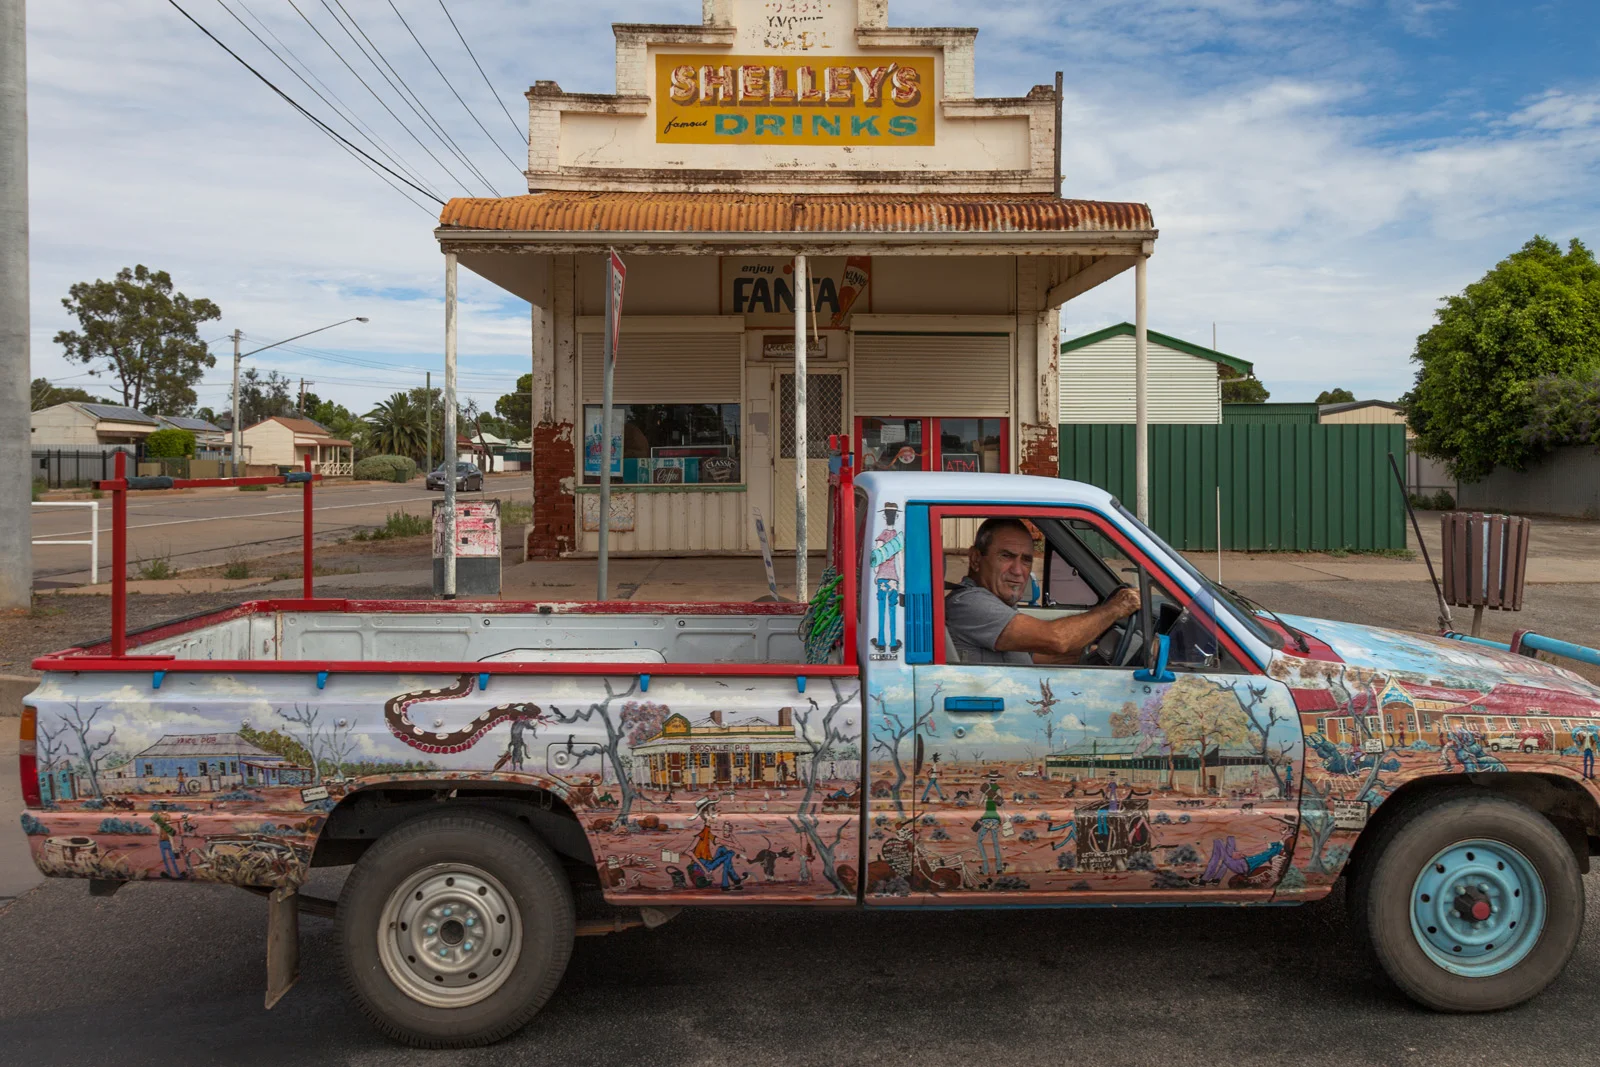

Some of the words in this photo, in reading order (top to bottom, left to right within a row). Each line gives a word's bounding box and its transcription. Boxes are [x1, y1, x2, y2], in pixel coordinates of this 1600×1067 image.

[669, 61, 921, 108] SHELLEY'S
[663, 116, 708, 134] famous
[714, 113, 918, 137] DRINKS
[742, 264, 775, 274] enjoy
[733, 277, 841, 313] FANTA
[706, 459, 735, 469] CLASSIC
[946, 460, 975, 472] ATM
[656, 468, 680, 484] Coffee
[735, 744, 750, 752] PUB
